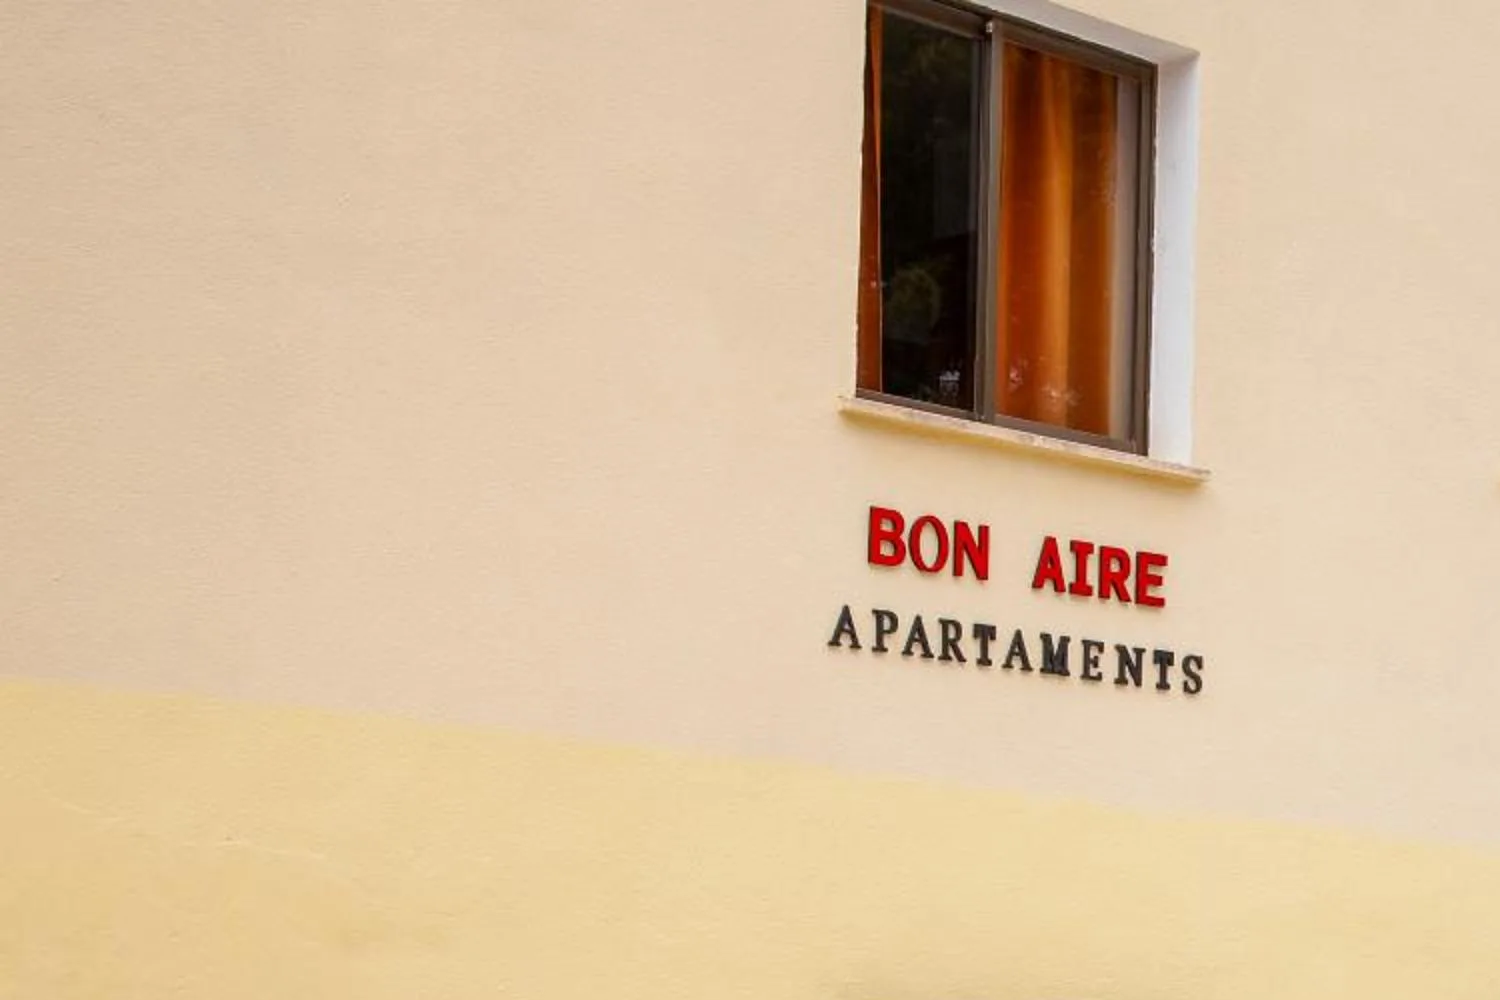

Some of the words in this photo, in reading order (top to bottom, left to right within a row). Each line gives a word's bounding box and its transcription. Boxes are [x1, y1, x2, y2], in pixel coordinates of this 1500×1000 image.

[867, 505, 991, 581] BON
[1032, 536, 1169, 608] AIRE
[828, 605, 1203, 695] APARTAMENTS
